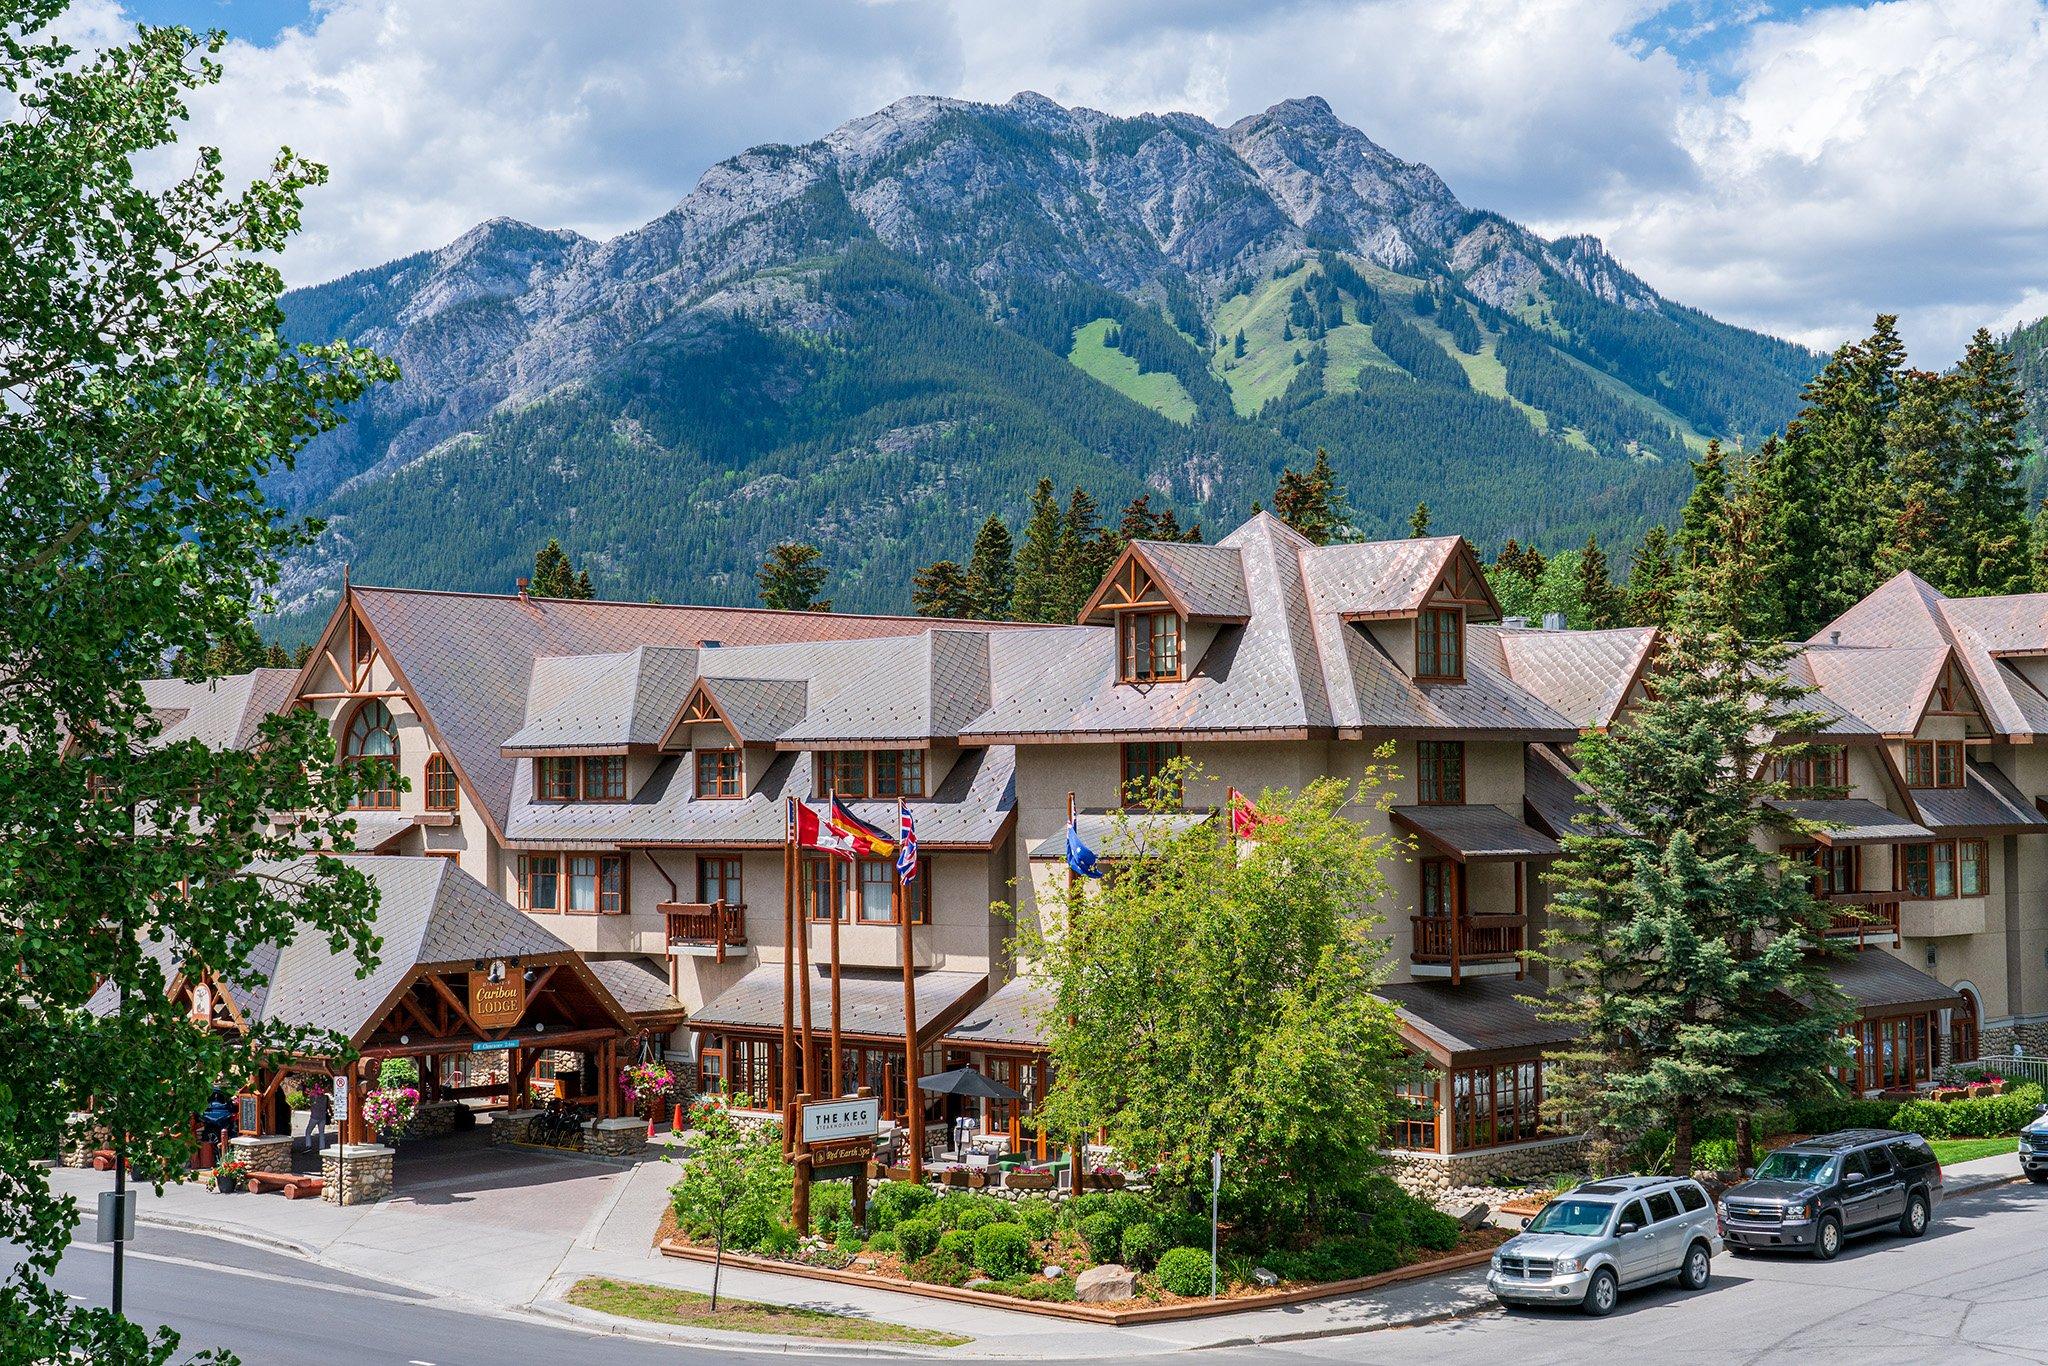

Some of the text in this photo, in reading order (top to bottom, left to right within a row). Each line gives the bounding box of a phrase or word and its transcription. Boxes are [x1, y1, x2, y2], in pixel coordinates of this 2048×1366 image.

[477, 986, 517, 1001] Caribou
[478, 1000, 517, 1013] LODGE
[816, 1110, 867, 1124] THE KEG
[826, 1147, 870, 1160] Red Earth Spa
